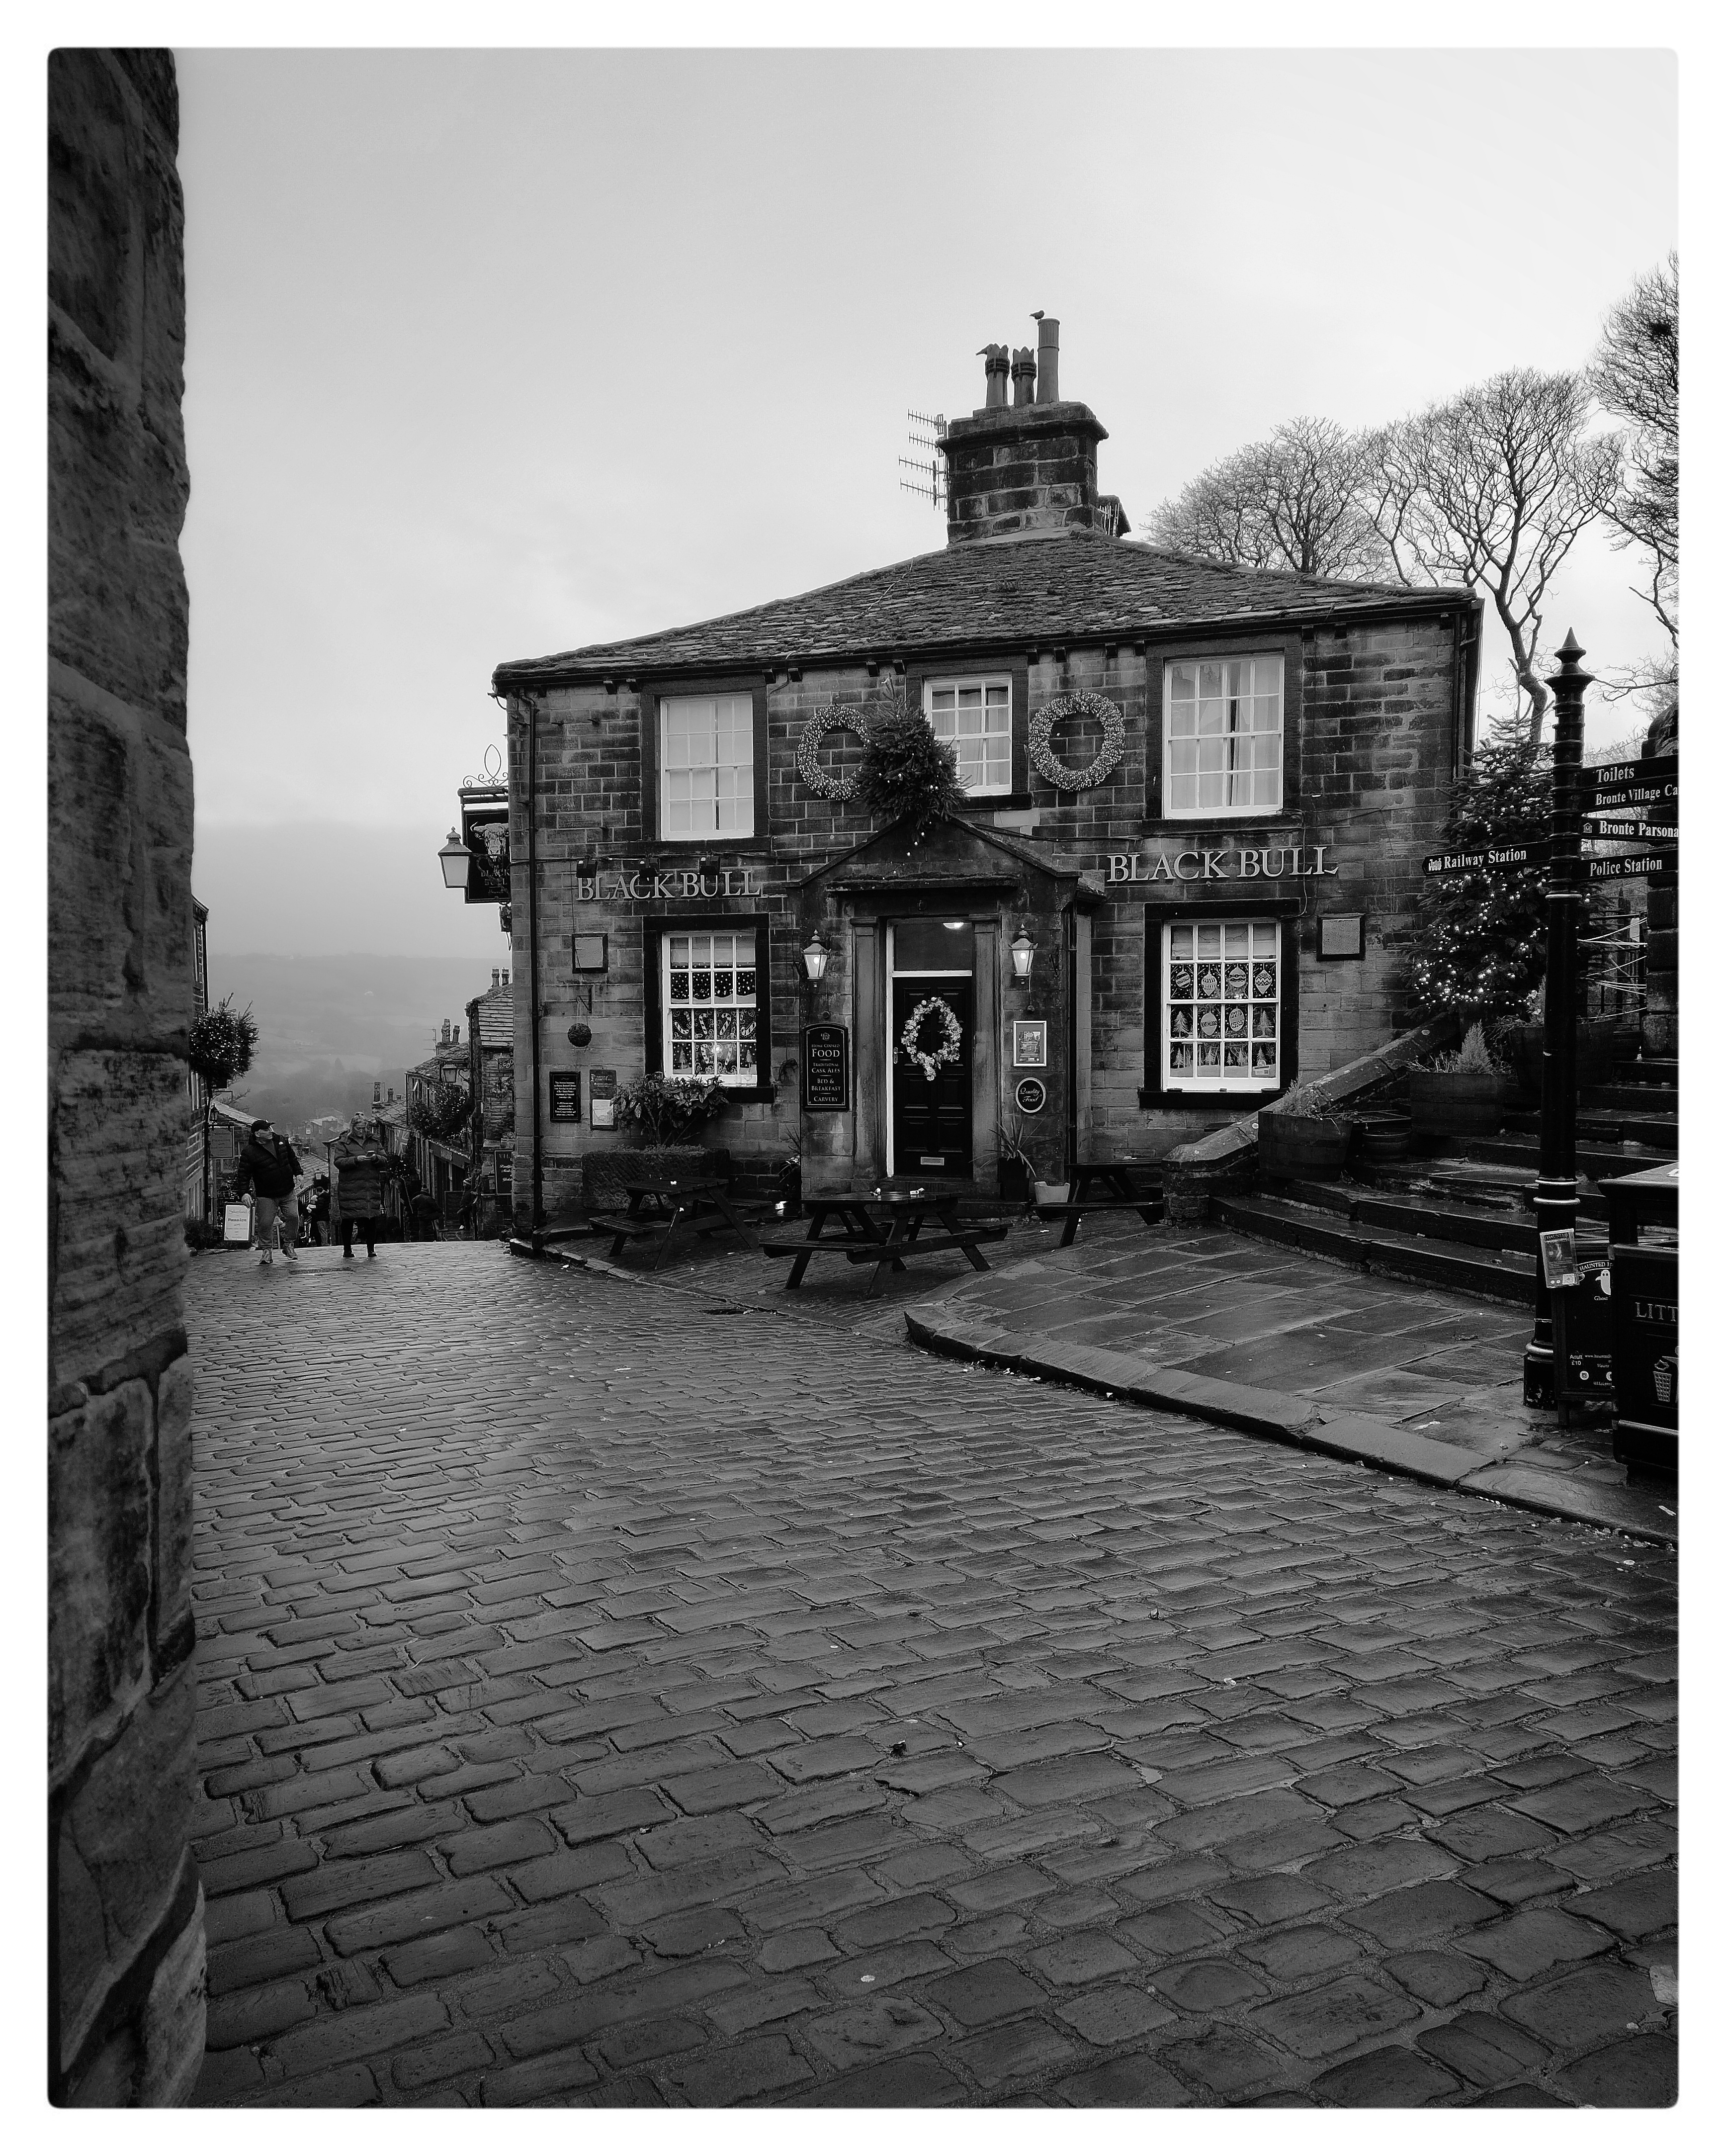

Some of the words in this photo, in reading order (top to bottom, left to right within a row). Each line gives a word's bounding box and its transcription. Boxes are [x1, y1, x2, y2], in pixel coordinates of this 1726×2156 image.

[1596, 766, 1635, 783] Toilets
[1595, 792, 1626, 806] Bronte
[1629, 788, 1660, 801] Village
[1599, 820, 1635, 835] Bronte
[1107, 850, 1230, 882] BLACK
[1236, 846, 1339, 878] BULL
[1444, 854, 1484, 869] Railway
[1488, 848, 1527, 864] Station
[1589, 861, 1621, 877] Police
[1625, 857, 1662, 873] Station
[576, 873, 676, 900] BLACK
[680, 871, 761, 897] BULL
[811, 1048, 840, 1057] FOOD
[1019, 1087, 1042, 1097] Quality
[1579, 1261, 1606, 1271] HAUNTED
